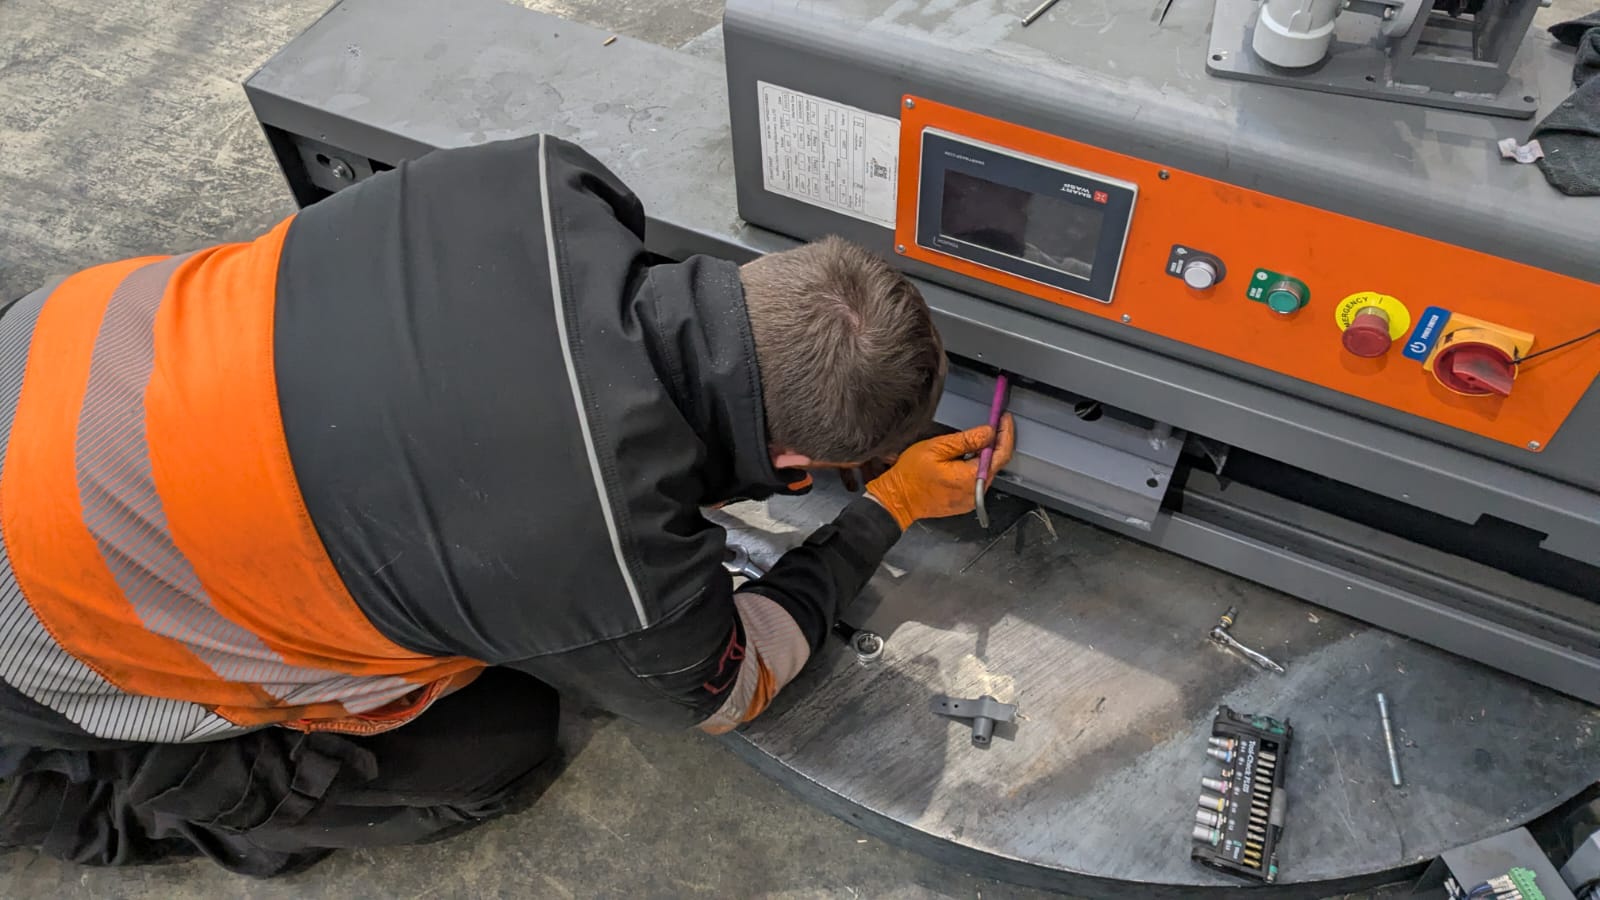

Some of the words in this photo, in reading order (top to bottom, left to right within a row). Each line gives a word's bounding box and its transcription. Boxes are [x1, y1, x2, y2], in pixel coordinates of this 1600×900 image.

[1060, 187, 1092, 198] SMART
[1063, 183, 1090, 194] WASP
[1341, 296, 1369, 328] MERGENCY
